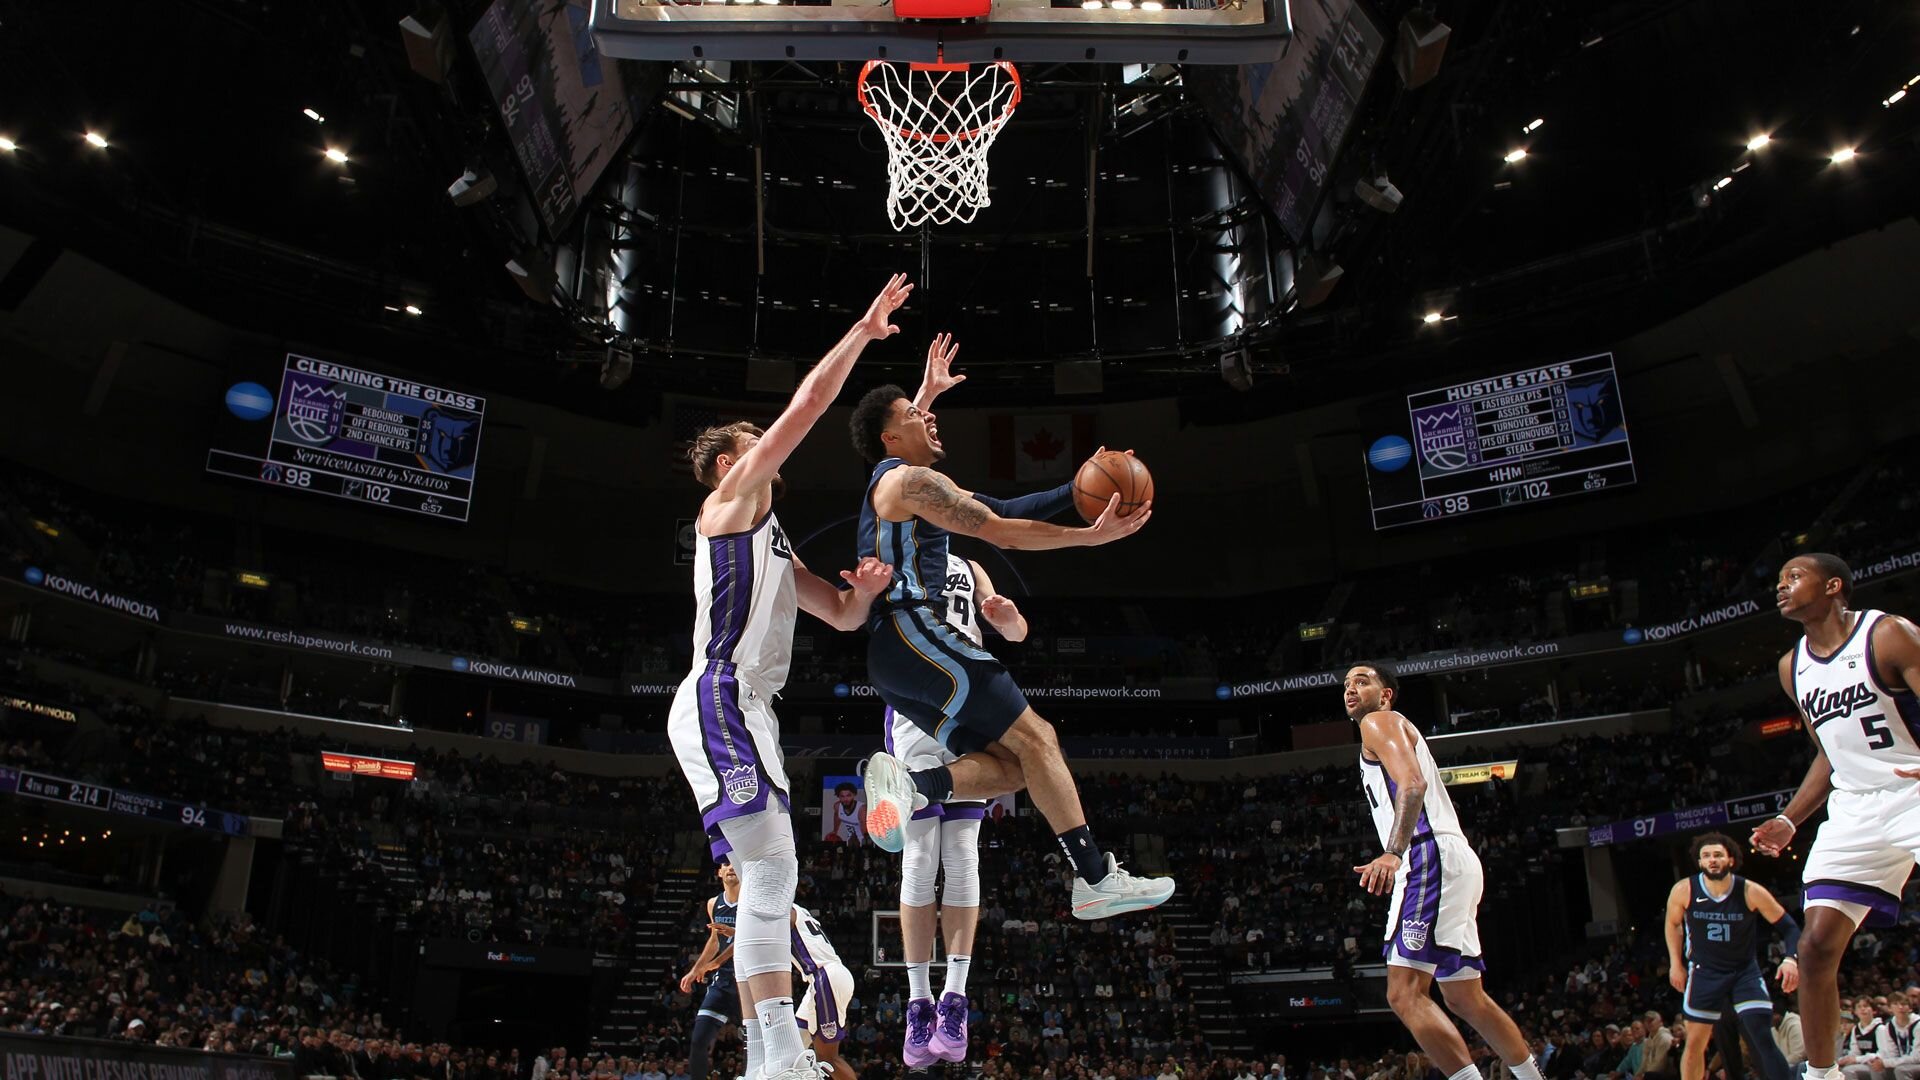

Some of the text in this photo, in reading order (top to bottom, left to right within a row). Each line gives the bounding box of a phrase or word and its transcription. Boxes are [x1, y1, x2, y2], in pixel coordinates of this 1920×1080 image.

[1336, 21, 1364, 71] 2:14
[516, 74, 536, 103] 97
[501, 93, 519, 127] 94
[1296, 137, 1312, 169] 97
[1309, 157, 1327, 187] 94
[550, 174, 573, 215] 2:14
[296, 359, 476, 411] CLEANING THE GLASS
[1446, 364, 1573, 402] HUSTLE STATS
[1552, 385, 1563, 396] 16
[1481, 388, 1543, 411] FASTBREAK PTS
[1554, 398, 1565, 408] 22
[362, 407, 403, 424] REBOUNDS
[1461, 403, 1472, 415] 16
[1498, 405, 1530, 420] ASSISTS
[1557, 409, 1567, 420] 13
[329, 425, 338, 435] 17
[351, 416, 409, 438] OFF REBOUNDS
[421, 420, 432, 431] 35
[1463, 416, 1474, 427] 22
[1492, 416, 1540, 433] TURNOVERS
[1559, 422, 1570, 433] 22
[346, 429, 411, 450] 2ND CHANCE PTS
[422, 432, 428, 442] 9
[1465, 428, 1476, 439] 19
[1482, 425, 1556, 448] PTS OFF TURNOVERS
[1563, 435, 1571, 445] 11
[1467, 440, 1478, 451] 22
[1505, 443, 1536, 456] STEALS
[1471, 452, 1478, 463] 9
[285, 469, 312, 487] 98
[386, 471, 399, 483] by
[1489, 465, 1523, 483] HHM
[1522, 481, 1550, 499] 102
[1583, 477, 1608, 490] 6:57
[364, 484, 390, 503] 102
[420, 502, 443, 515] 6:57
[1444, 496, 1470, 515] 98
[44, 573, 160, 622] KONICA MINOLTA
[1643, 600, 1760, 641] KONICA MINOLTA
[225, 622, 393, 660] www.reshapework.com
[1395, 641, 1559, 674] www.reshapework.com
[469, 660, 576, 688] KONICA MINOLTA
[1232, 672, 1338, 698] KONICA MINOLTA
[33, 703, 77, 723] MINOLTA
[1802, 682, 1878, 728] Kings
[490, 720, 516, 740] 95
[1860, 713, 1895, 751] 5
[1454, 770, 1480, 780] STREAM
[1480, 769, 1490, 777] ON
[25, 776, 42, 792] 4TH
[728, 779, 757, 793] KINGS
[68, 783, 99, 806] 2:14
[181, 806, 206, 827] 94
[1674, 806, 1723, 821] TIMEOUTS: 4
[1733, 804, 1750, 817] 4TH
[1634, 817, 1656, 837] 97
[1675, 818, 1711, 831] FOULS: 4
[1692, 911, 1744, 922] GRIZZLIES
[1403, 931, 1426, 941] KINGS
[1707, 923, 1731, 942] 21
[1289, 996, 1341, 1008] FedExForum
[6, 1053, 38, 1080] APP
[40, 1055, 82, 1080] WITH
